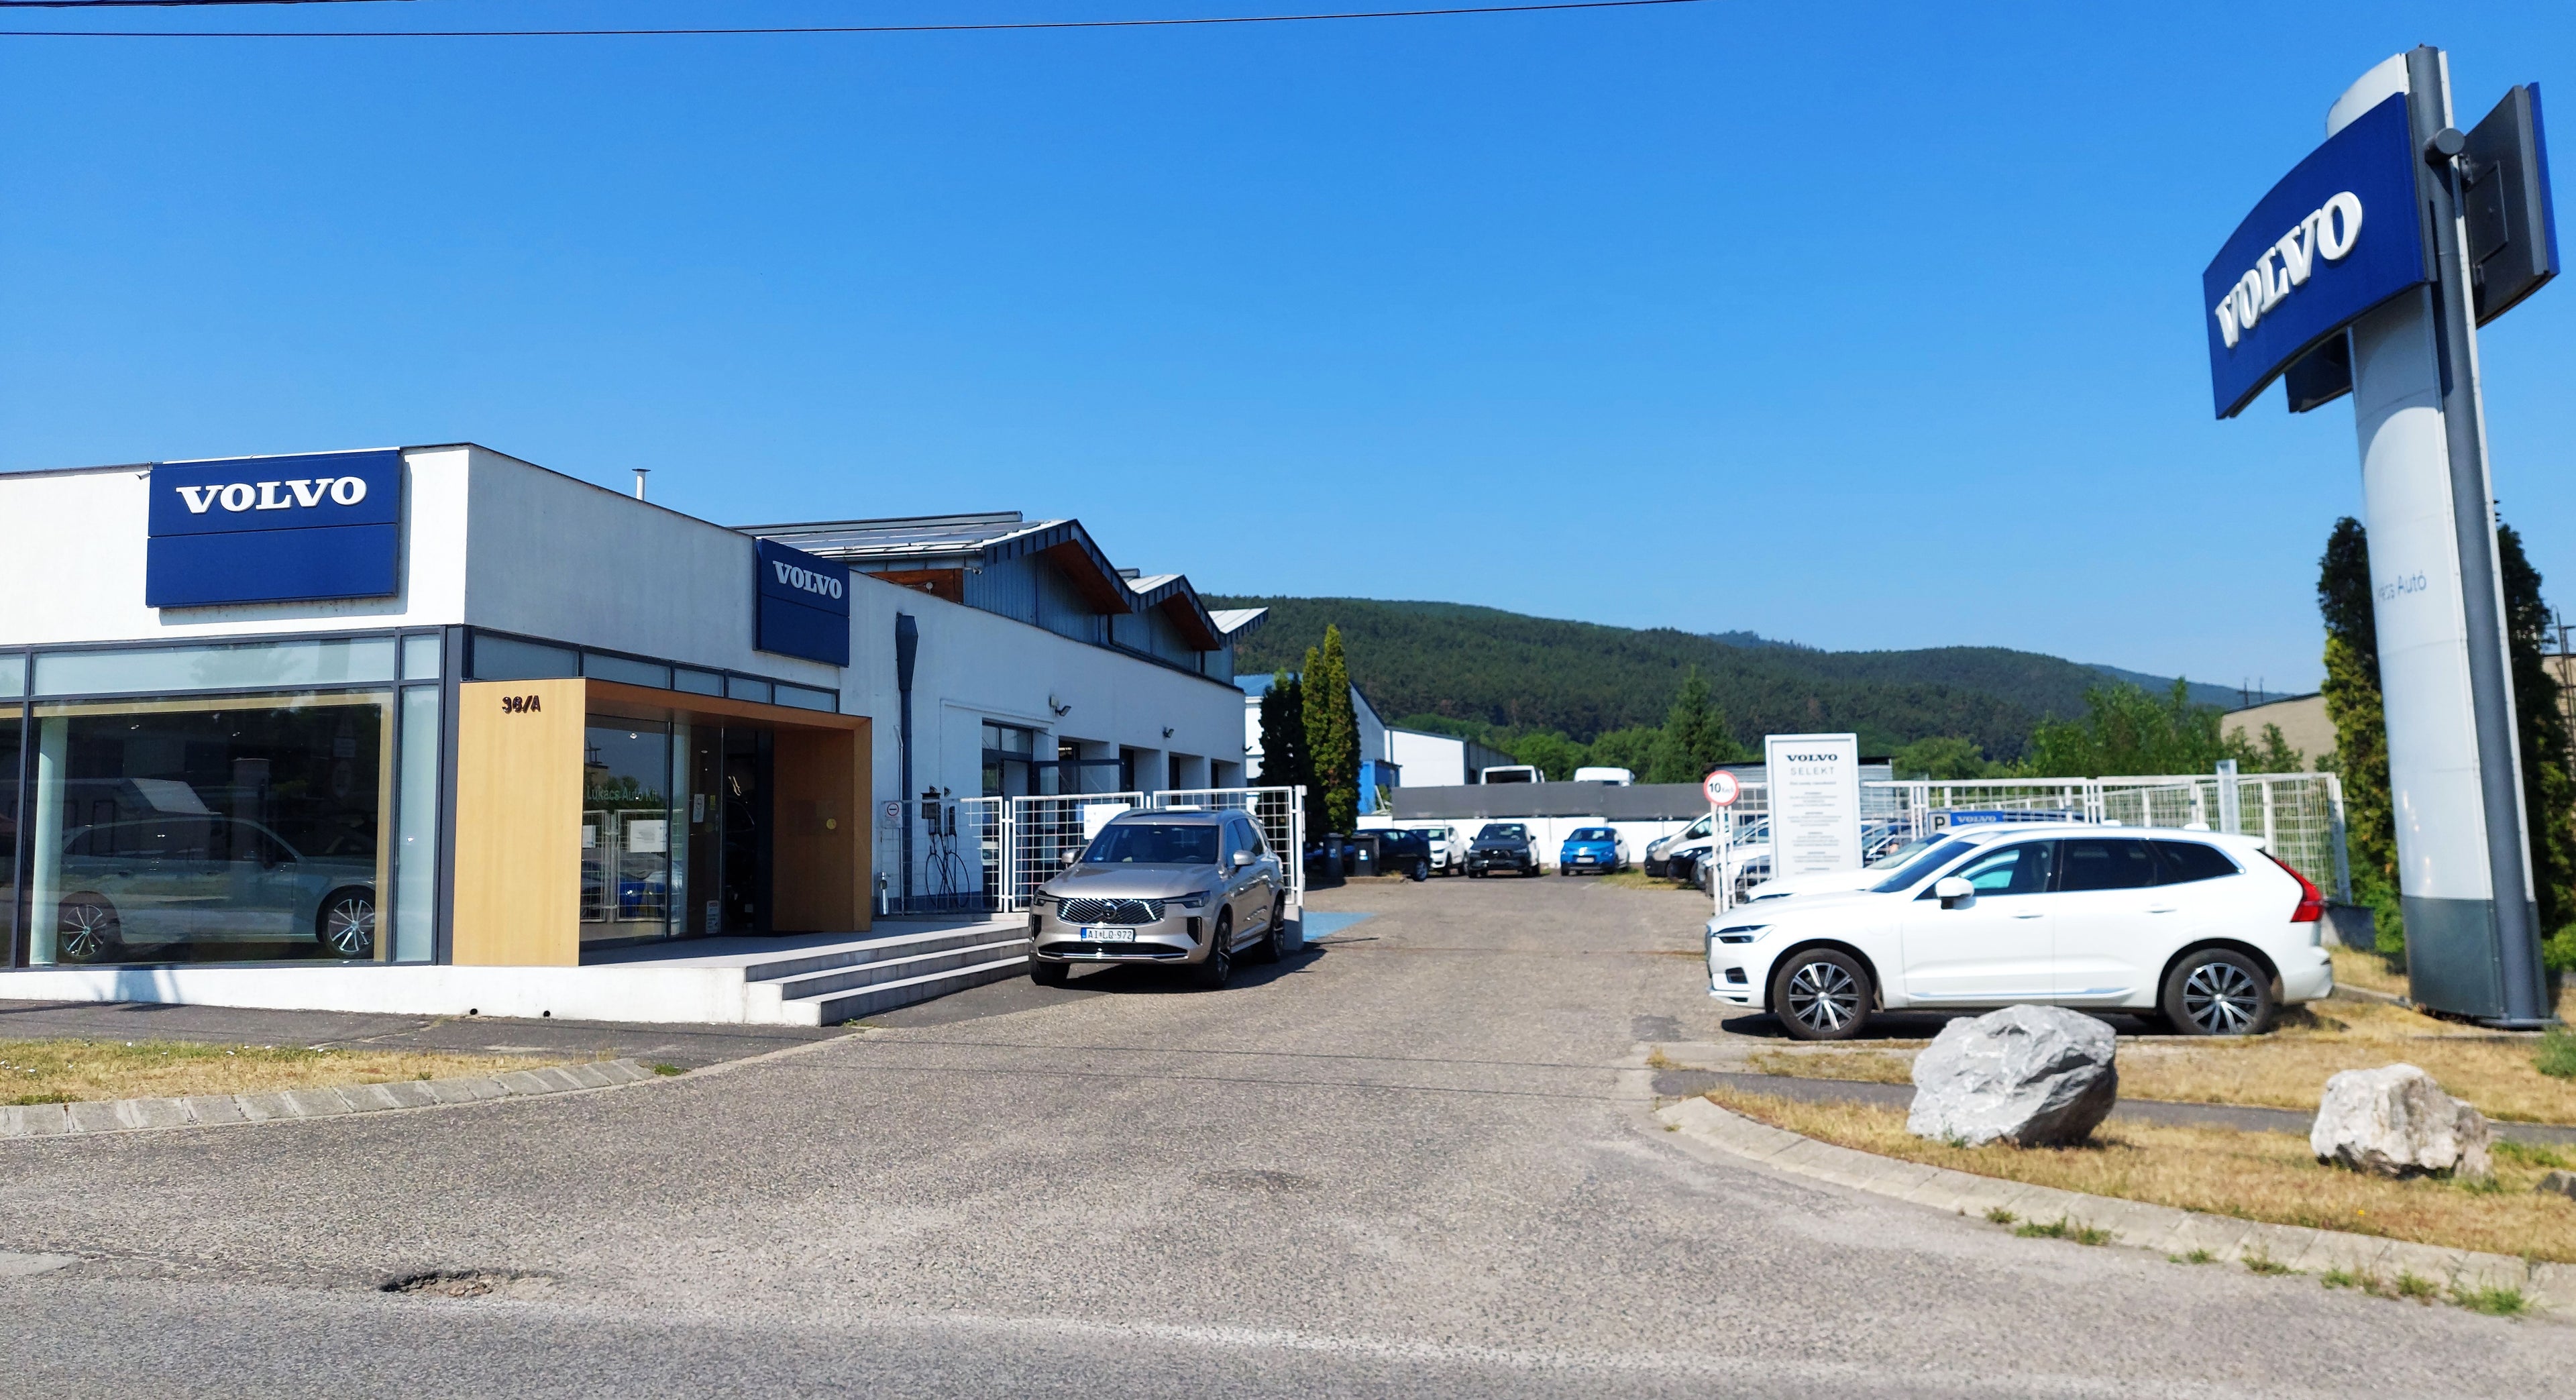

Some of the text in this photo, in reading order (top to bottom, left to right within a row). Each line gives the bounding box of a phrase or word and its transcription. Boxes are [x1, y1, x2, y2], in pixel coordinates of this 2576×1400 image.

[2215, 191, 2363, 349] VOLVO
[176, 476, 368, 514] VOLVO
[772, 560, 843, 600] VOLVO
[1786, 753, 1838, 762] VOLVO
[1790, 766, 1835, 775] SELEKT
[1709, 782, 1721, 793] 10
[1935, 815, 1997, 830] P VOLVO
